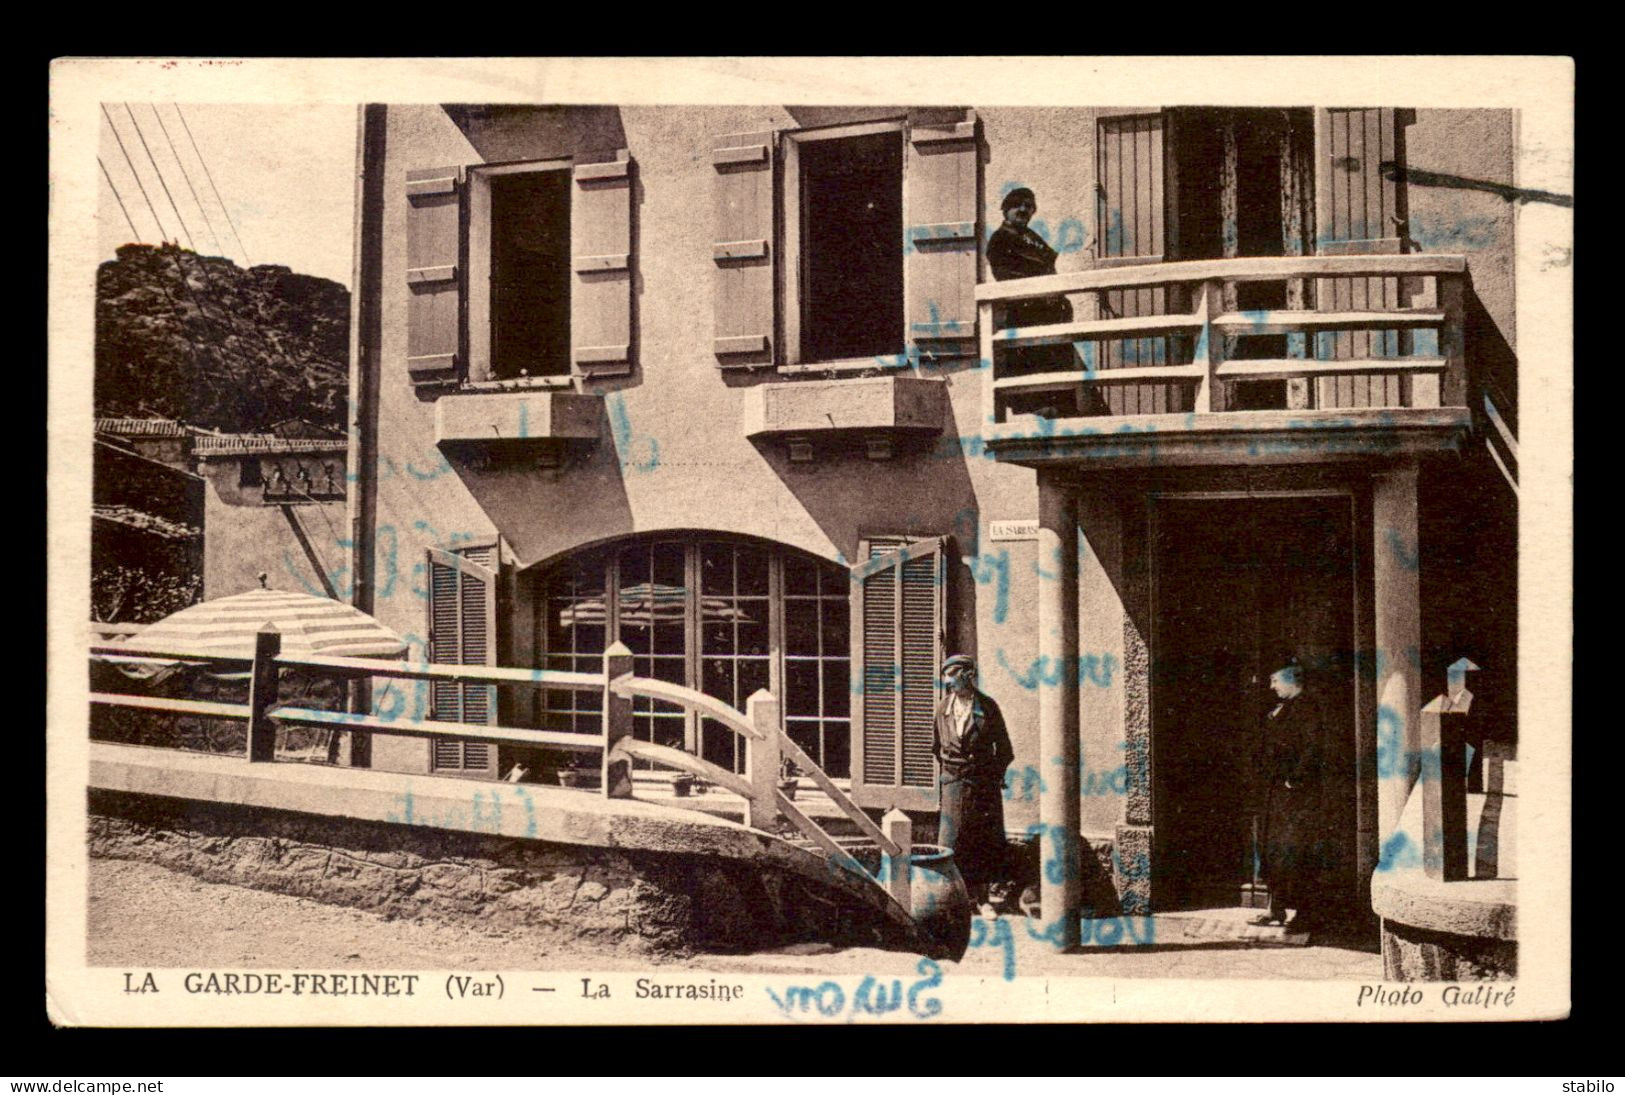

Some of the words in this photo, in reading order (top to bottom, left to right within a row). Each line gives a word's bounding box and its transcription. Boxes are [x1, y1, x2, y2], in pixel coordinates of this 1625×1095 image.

[124, 972, 160, 994] LA
[184, 972, 419, 997] GARDE-FREINET
[445, 974, 504, 1000] (Var)
[581, 978, 611, 998] La
[635, 978, 743, 1002] Sarrasine
[1357, 984, 1423, 1007] Photo
